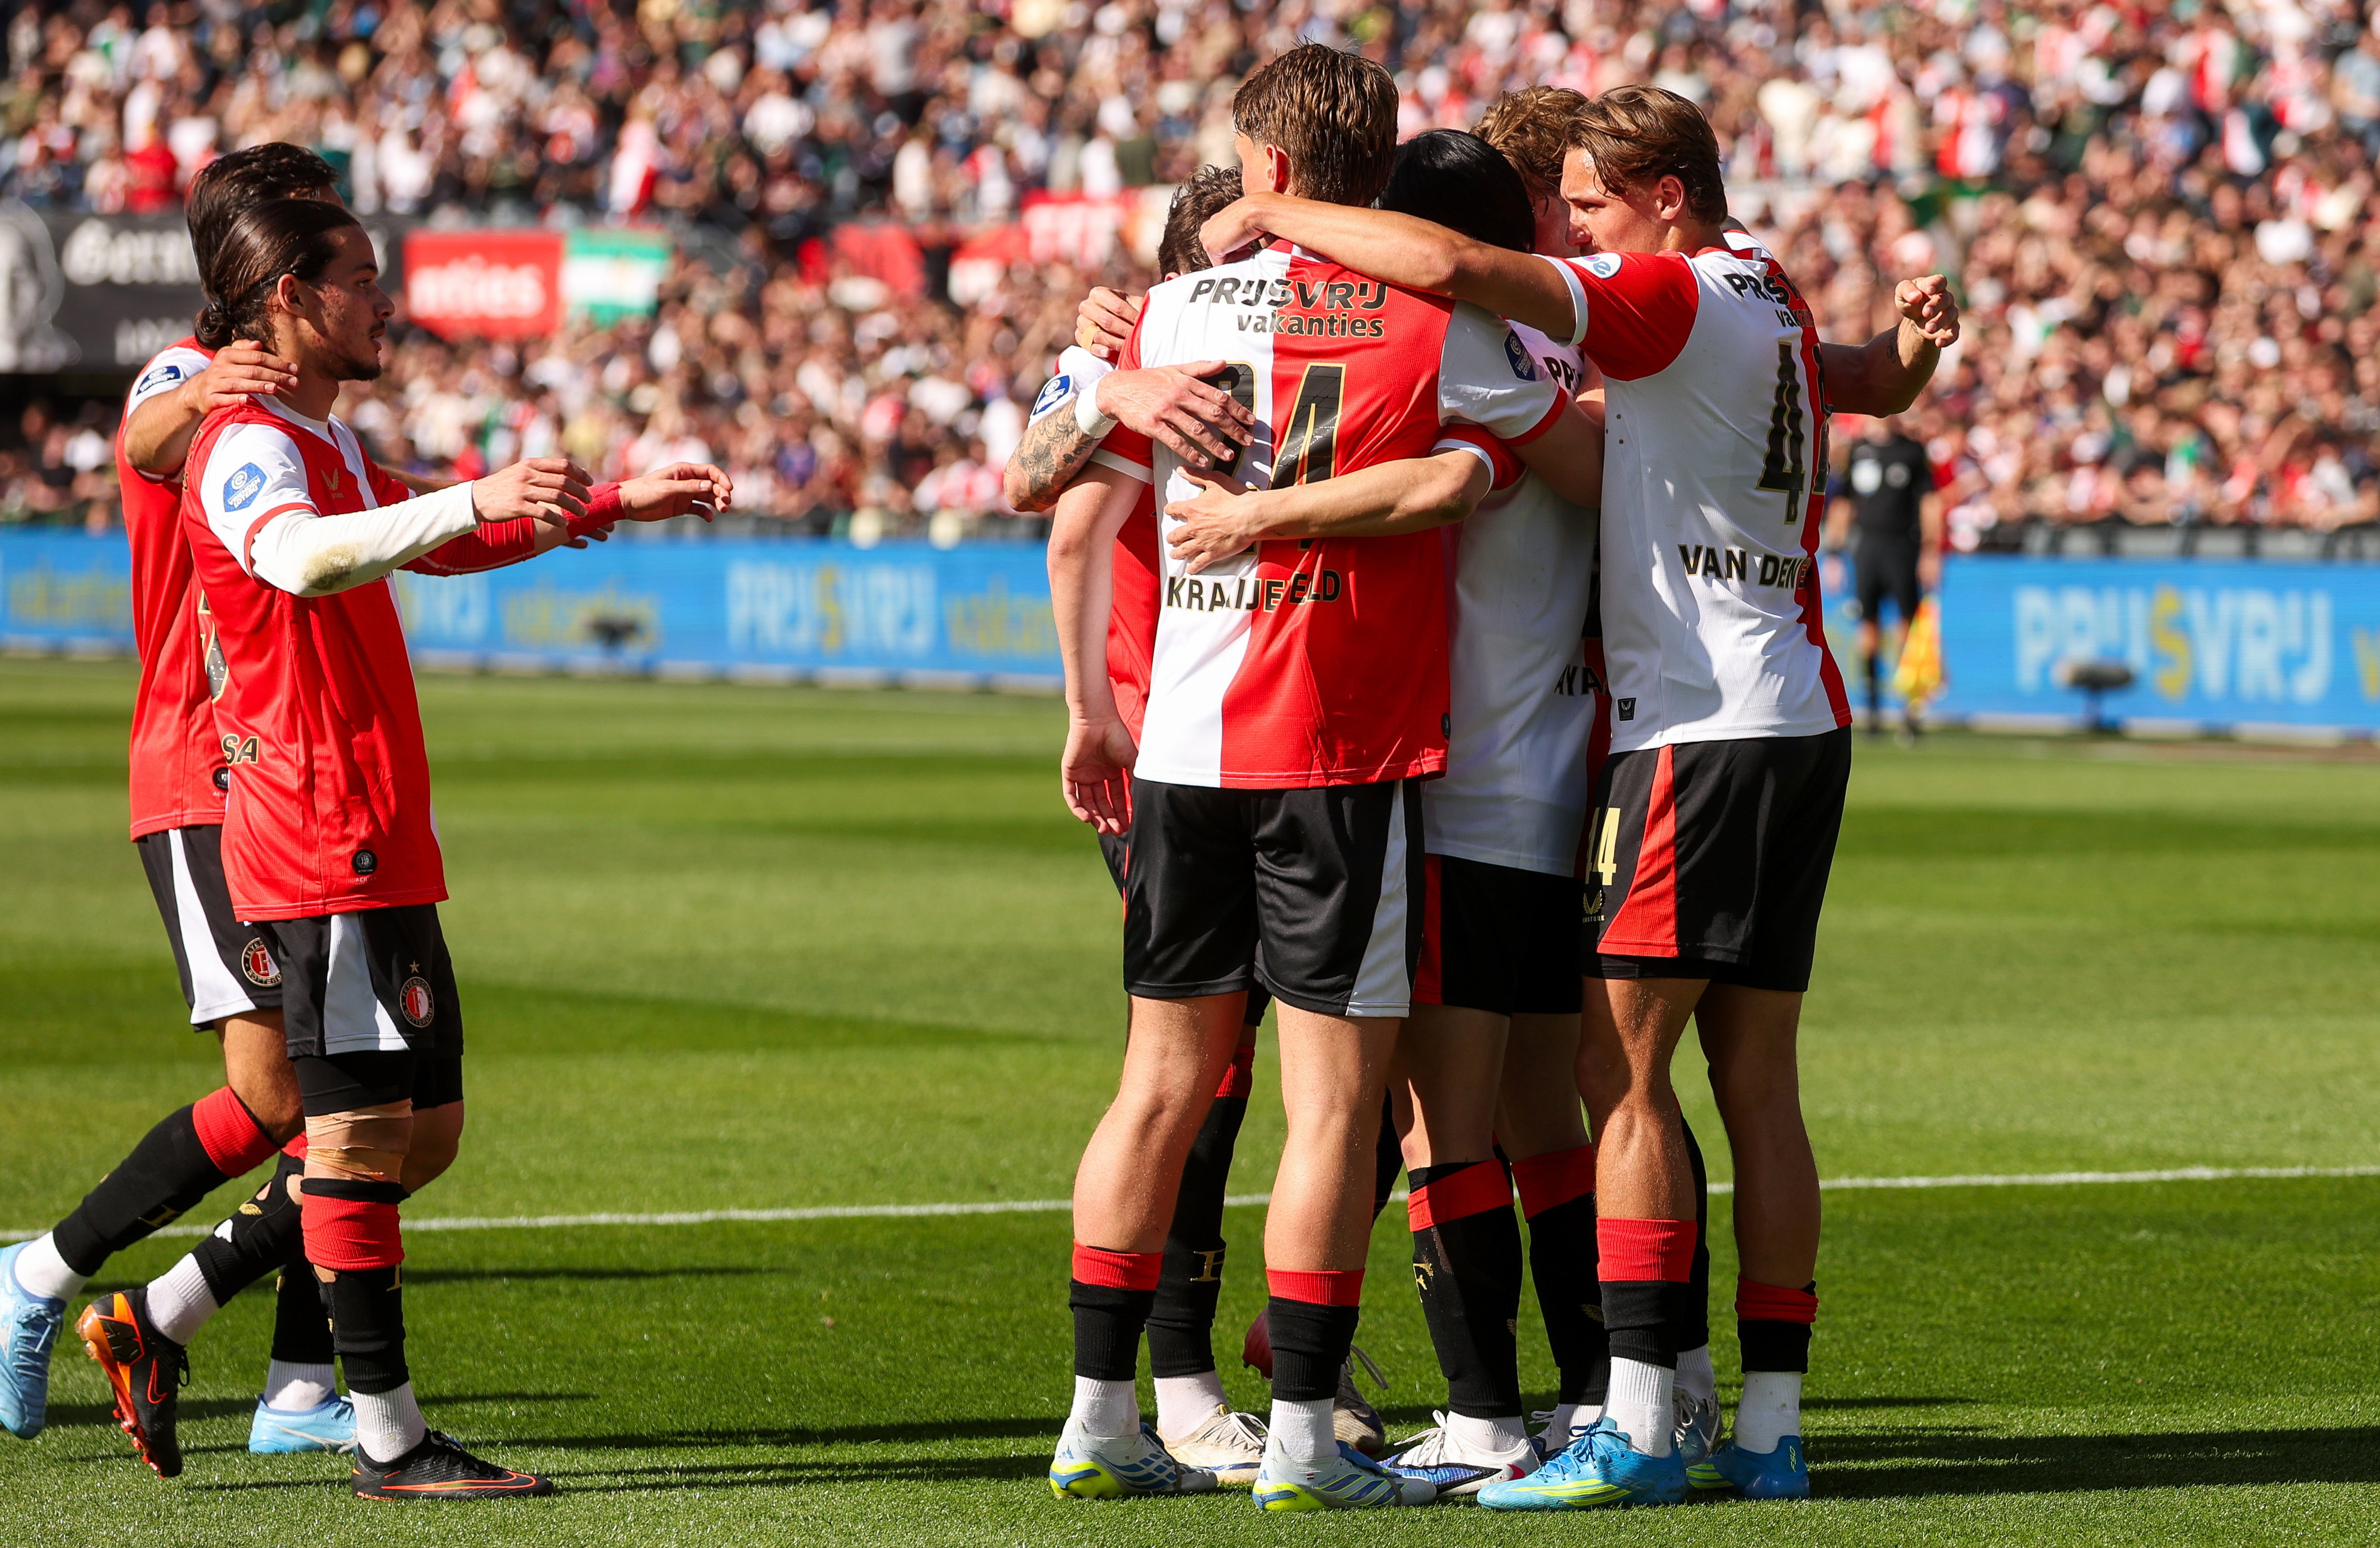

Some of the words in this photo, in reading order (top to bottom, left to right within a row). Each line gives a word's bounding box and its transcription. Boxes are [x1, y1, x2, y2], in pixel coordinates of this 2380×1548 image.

[1189, 277, 1388, 311] PRIJSVRIJ
[1237, 309, 1384, 338] vakanties
[1678, 543, 1748, 582] VAN
[2013, 580, 2333, 704] PRIJSVRIJ
[221, 733, 259, 766] SA
